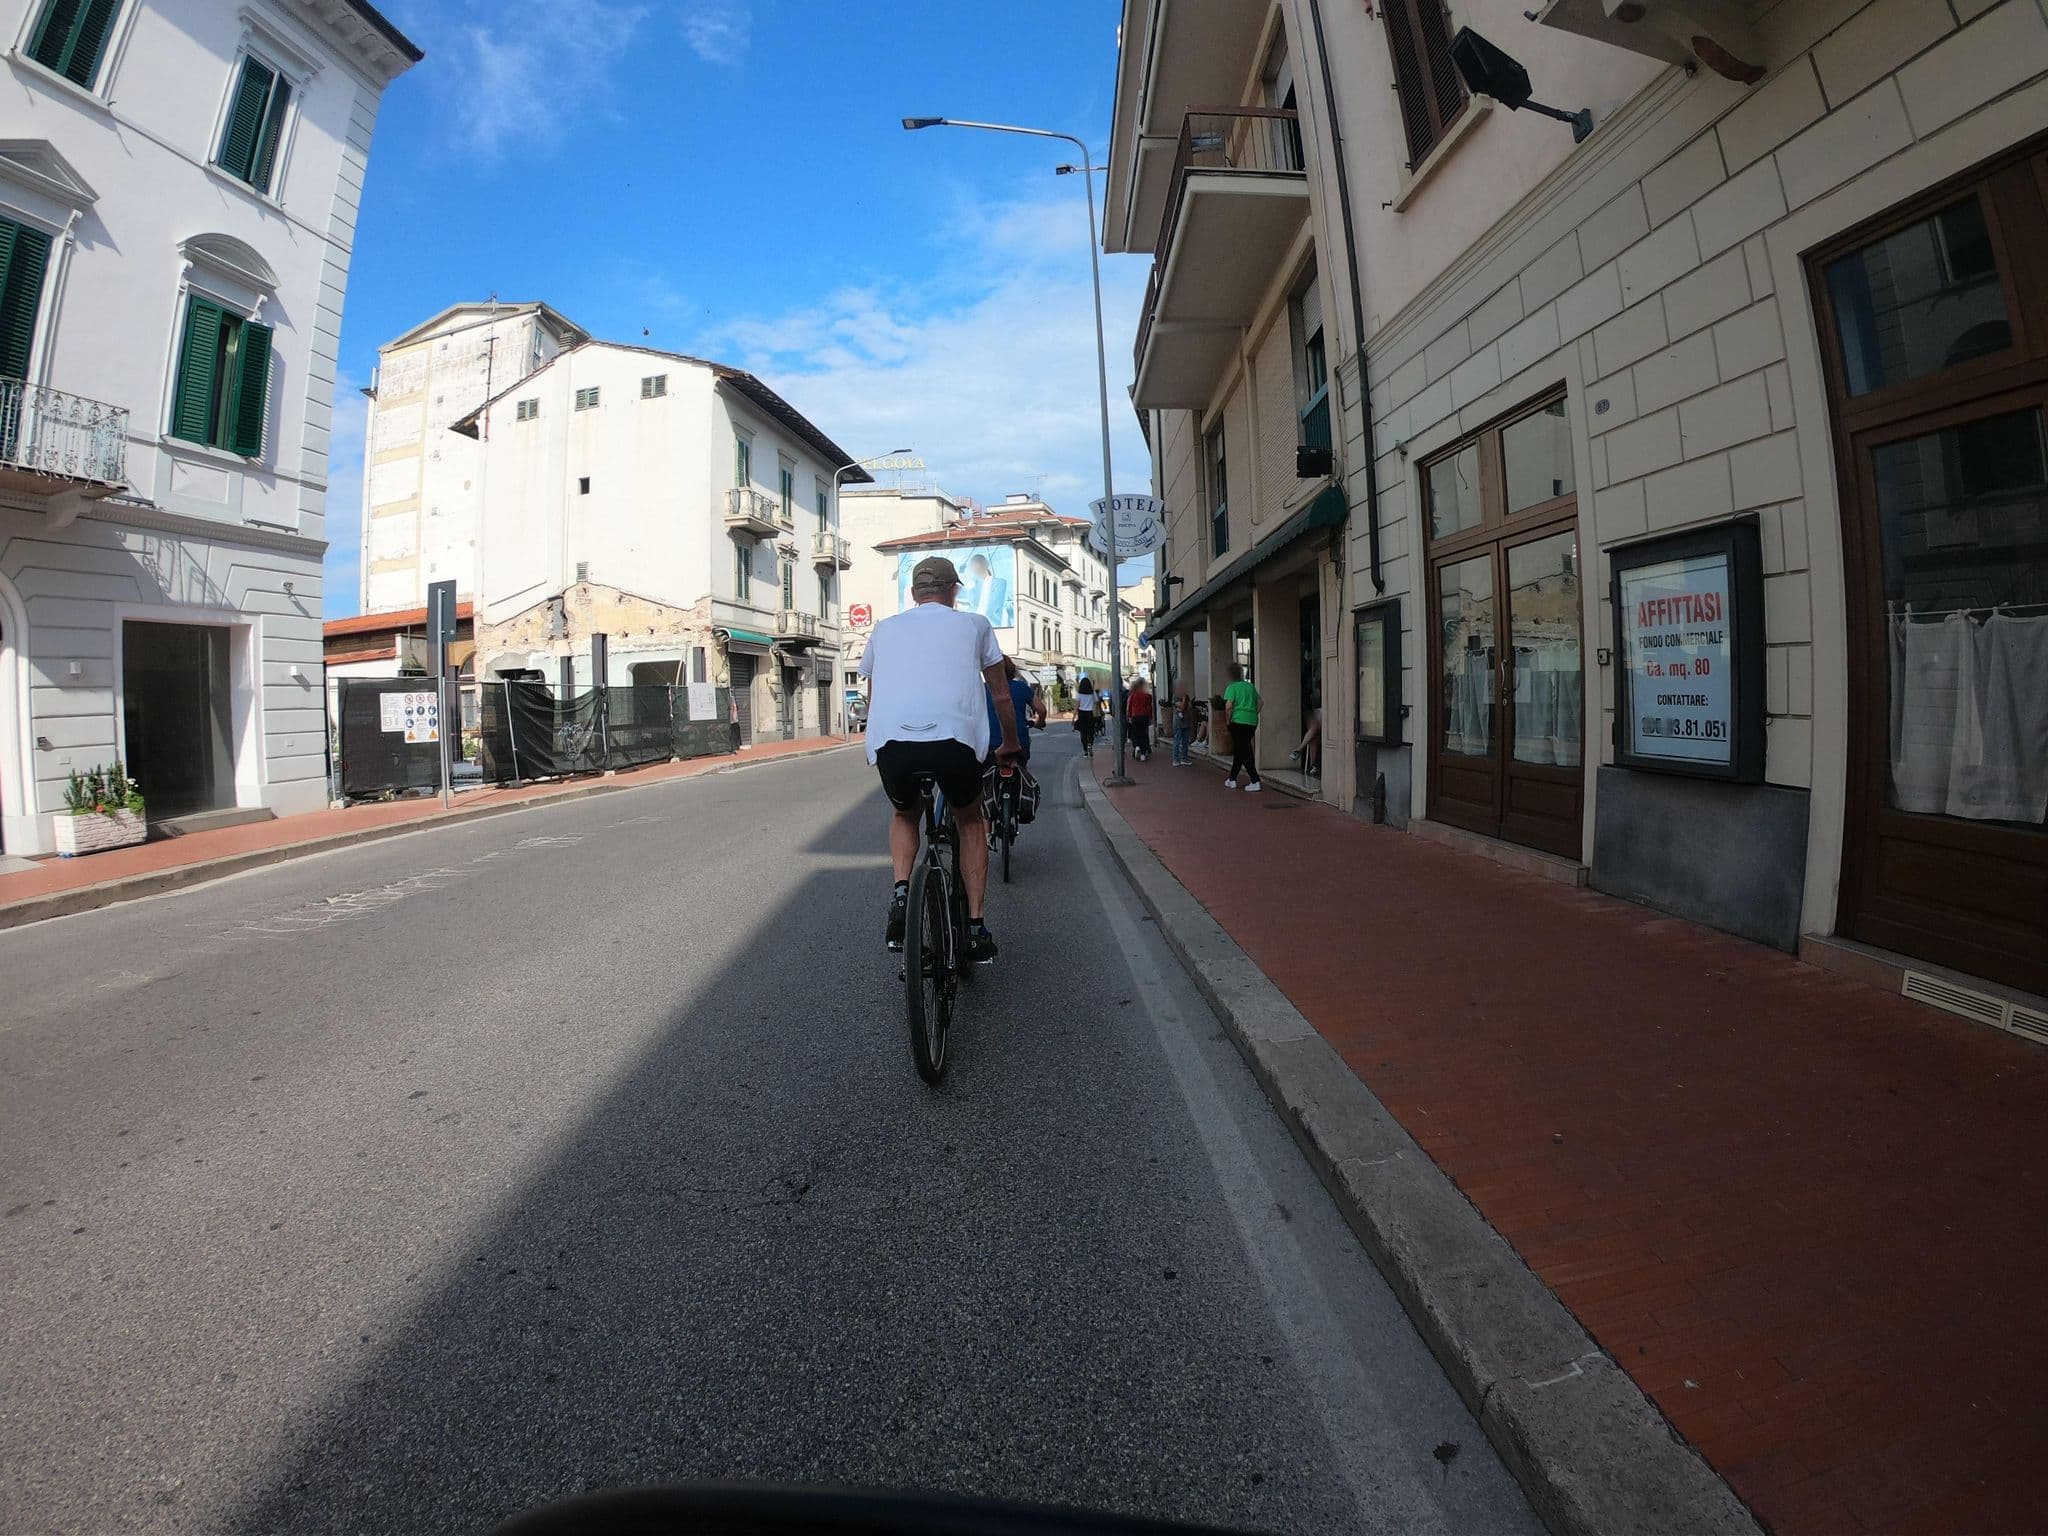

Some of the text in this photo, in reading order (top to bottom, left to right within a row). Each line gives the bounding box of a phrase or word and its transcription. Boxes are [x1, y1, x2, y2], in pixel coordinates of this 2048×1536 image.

[1638, 592, 1722, 627] AFFITTASI
[1639, 630, 1723, 648] FONDO COMMERCIALE
[1647, 658, 1710, 680] Ca. mq. 80
[1657, 694, 1709, 706] CONTATTARE:
[1664, 717, 1727, 738] 3.81.051
